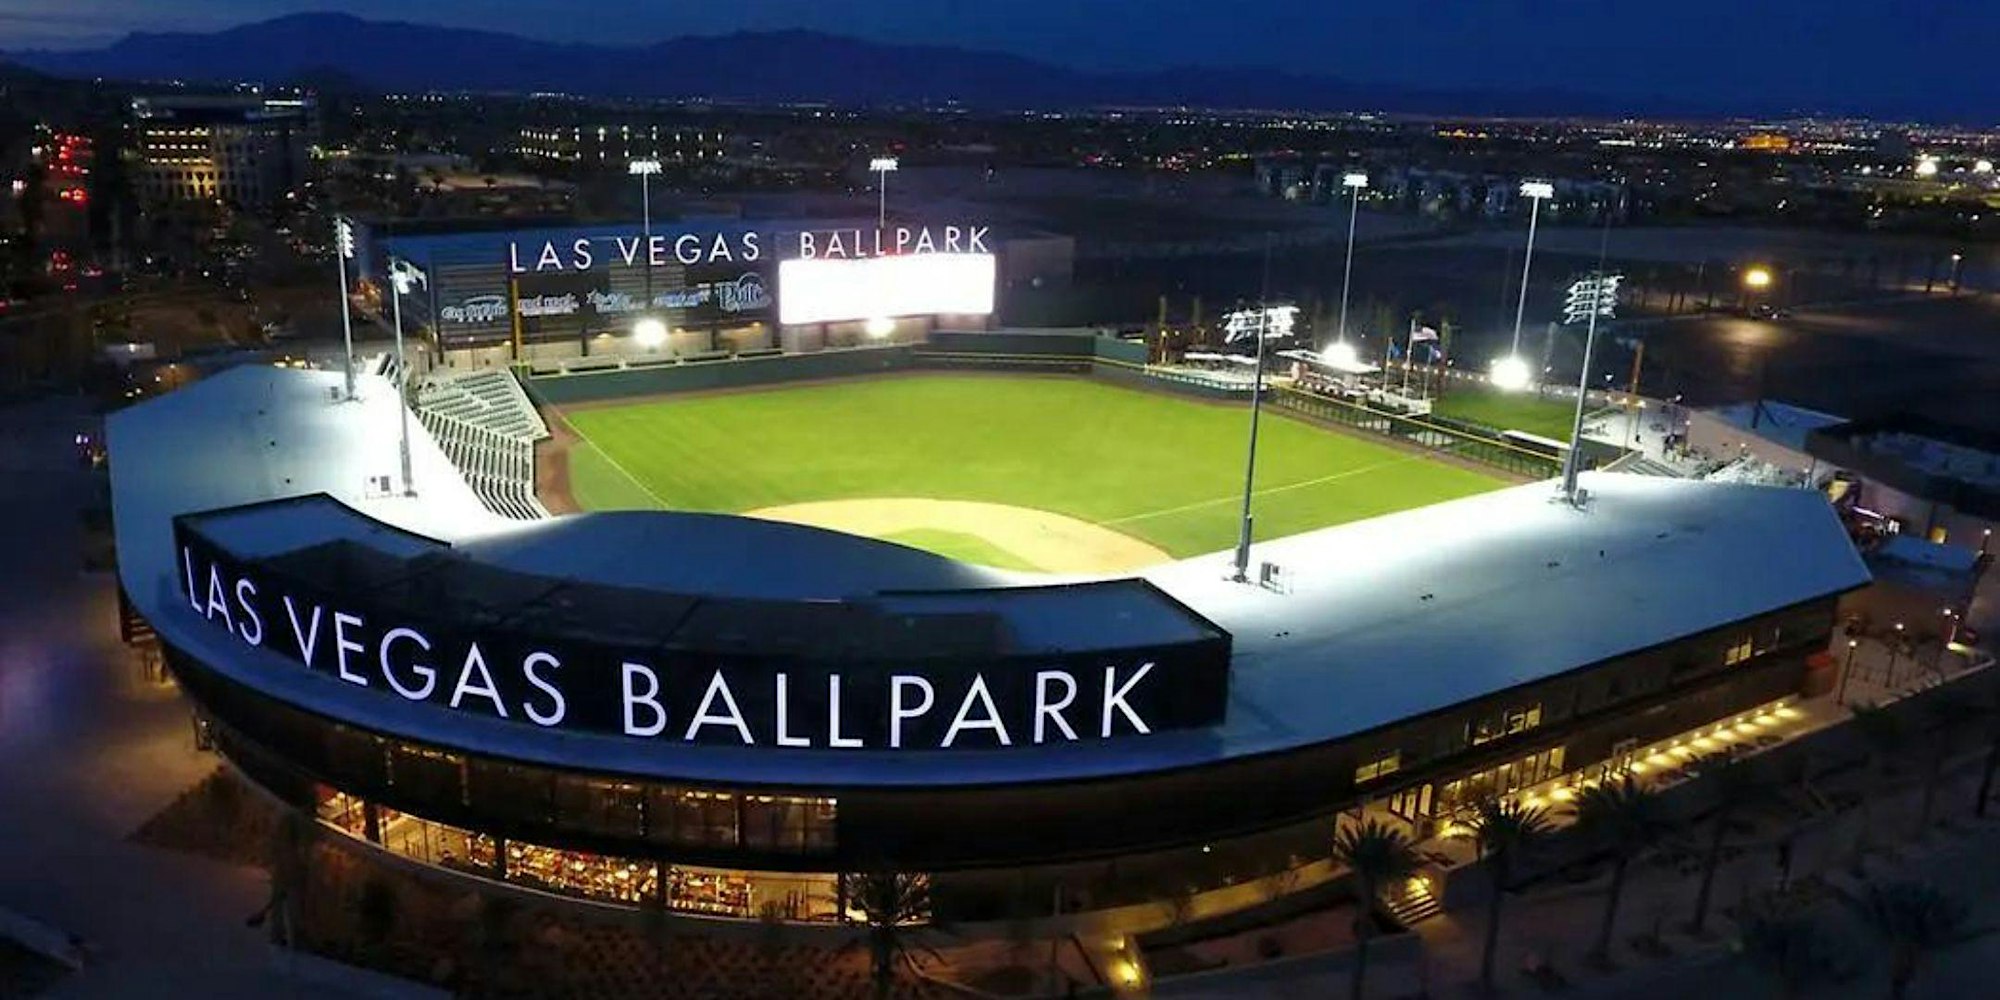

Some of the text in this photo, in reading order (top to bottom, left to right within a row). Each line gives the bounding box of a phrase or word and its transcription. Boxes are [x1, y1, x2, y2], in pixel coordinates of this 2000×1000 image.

[510, 226, 990, 272] LAS VEGAS BALLPARK
[184, 546, 1155, 749] LAS VEGAS BALLPARK
